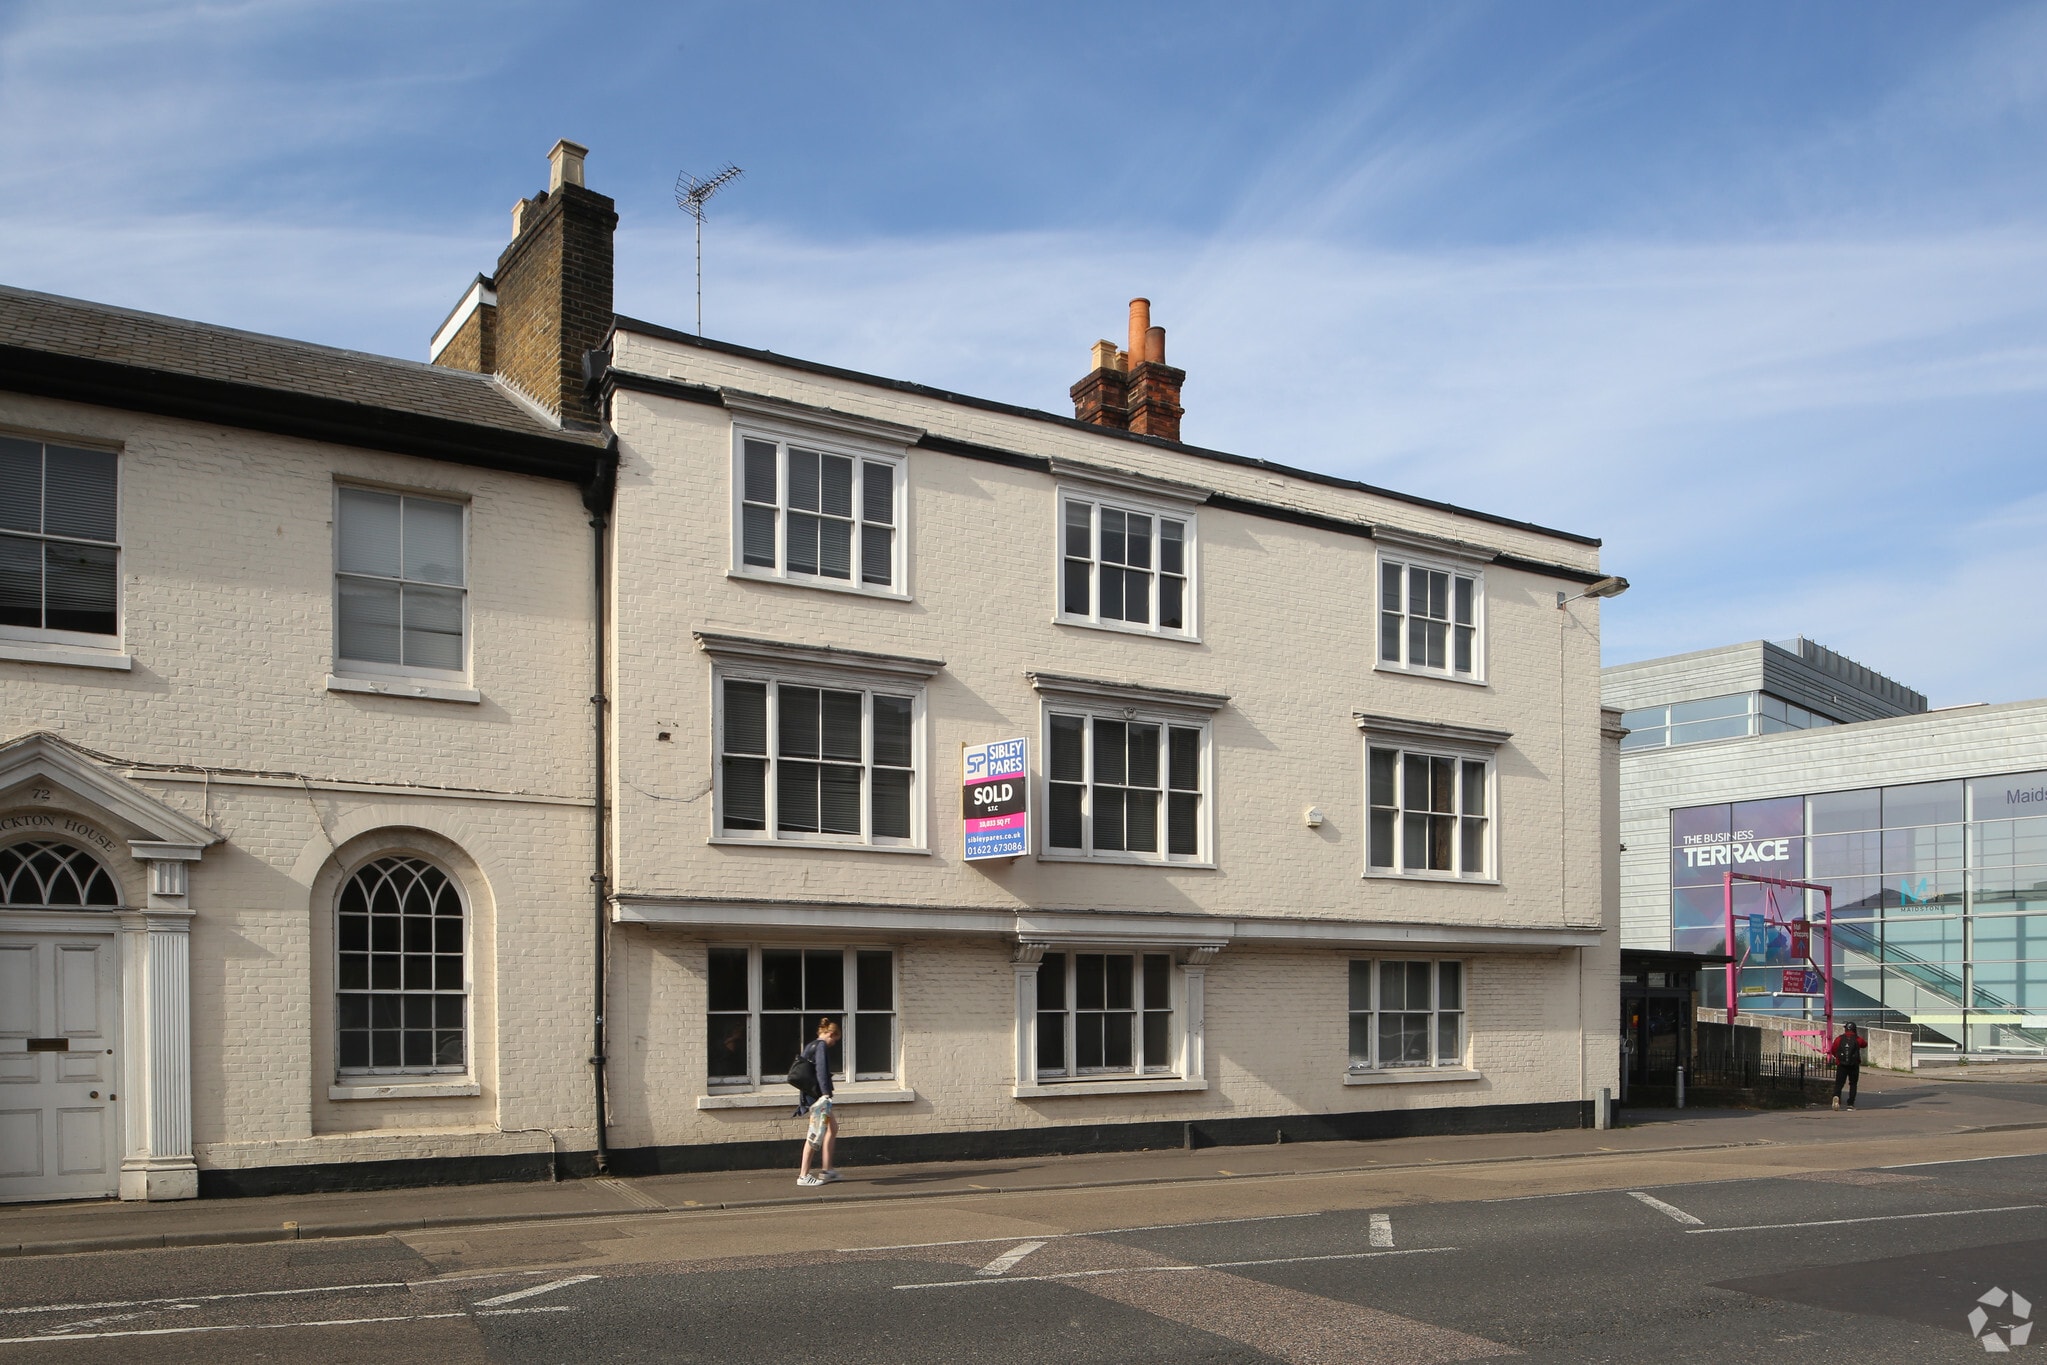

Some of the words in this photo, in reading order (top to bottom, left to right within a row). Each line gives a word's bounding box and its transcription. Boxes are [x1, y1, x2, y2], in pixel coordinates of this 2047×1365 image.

[989, 741, 1023, 761] SIBLEY
[990, 757, 1022, 776] PARES
[32, 788, 51, 800] 72
[974, 783, 1013, 805] SOLD
[996, 819, 1004, 827] SQ
[64, 820, 117, 852] HOUSE
[967, 831, 1021, 843] sibleypares.co.uk
[1683, 834, 1703, 845] THE
[1703, 830, 1754, 843] BUSINESS
[967, 845, 991, 855] 01622
[993, 842, 1022, 853] 673086
[1683, 839, 1790, 868] TERRACE
[1900, 904, 1944, 912] MAIDSTONE
